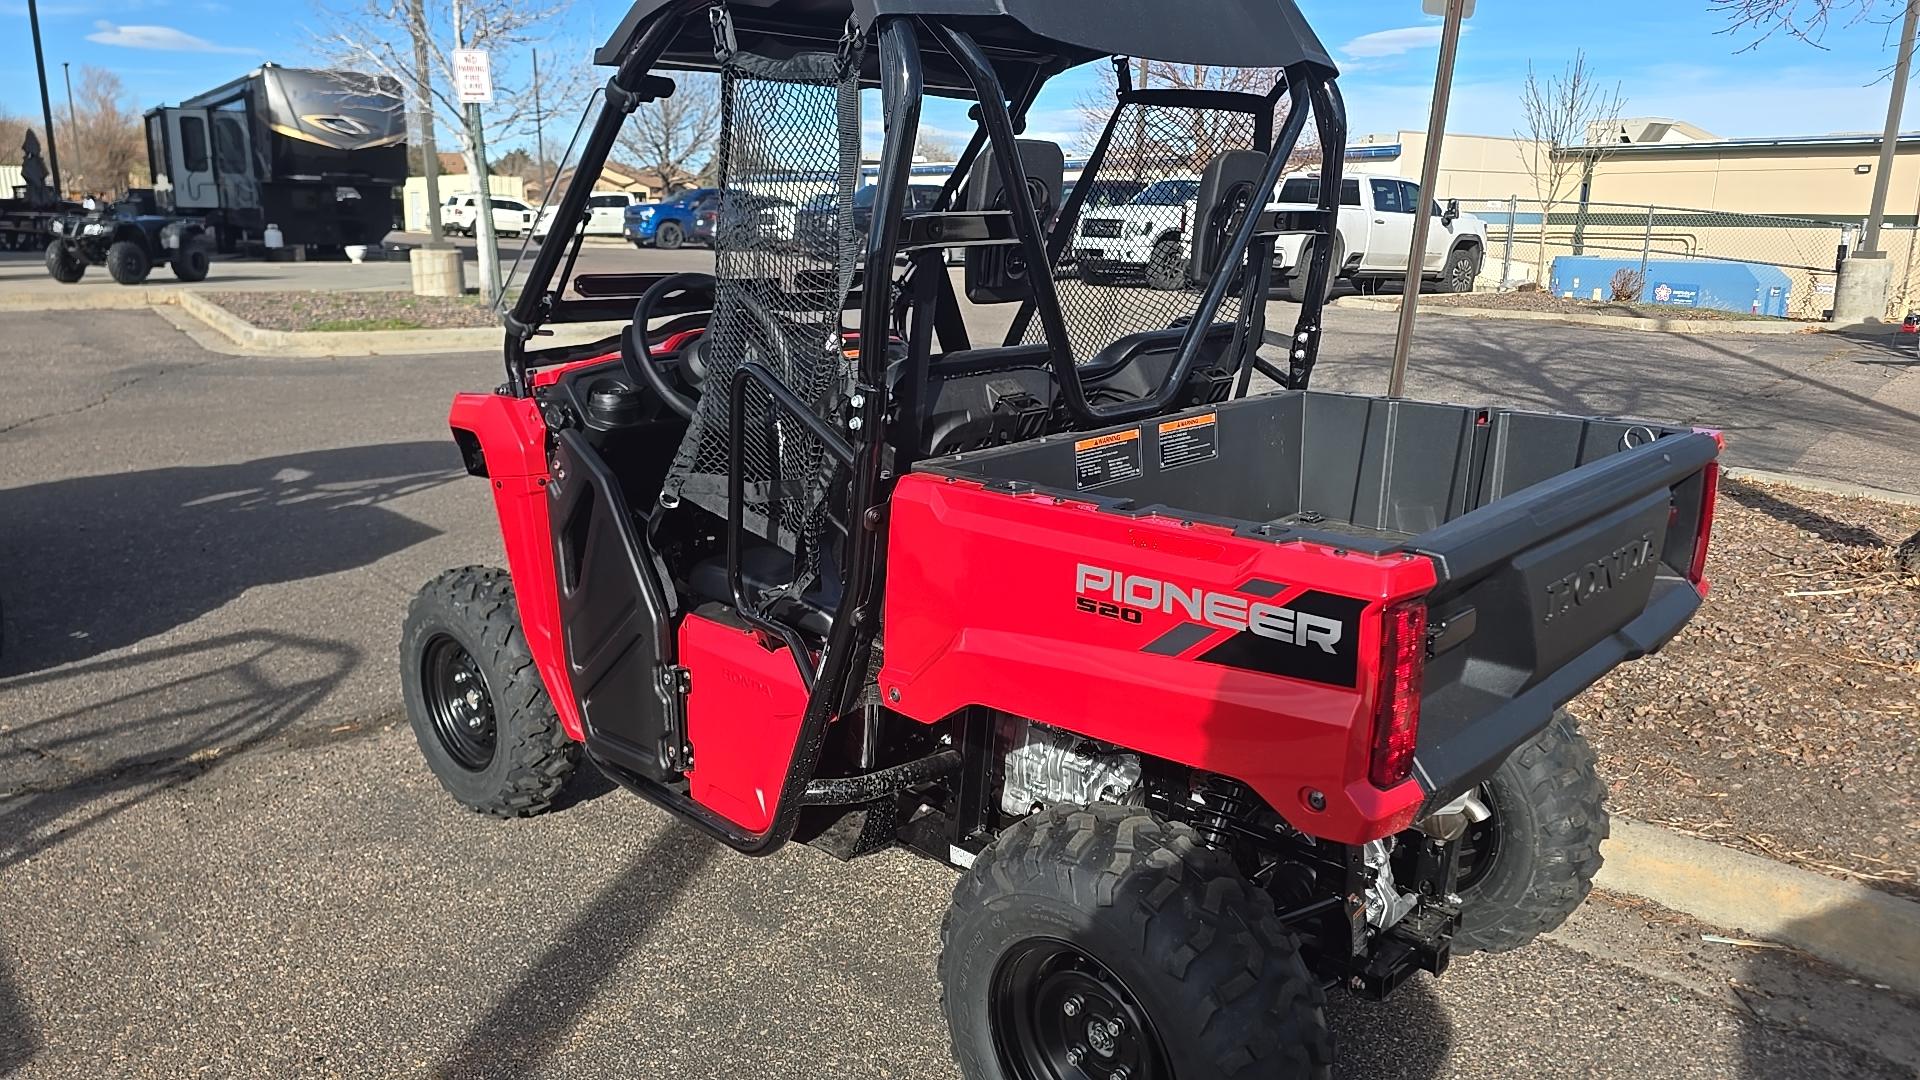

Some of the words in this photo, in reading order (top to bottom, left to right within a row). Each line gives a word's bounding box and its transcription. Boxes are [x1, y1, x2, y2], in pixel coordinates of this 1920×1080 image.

[1098, 434, 1121, 445] WARNING
[1075, 562, 1343, 655] PIONEER
[1542, 530, 1657, 626] HONDA
[1075, 596, 1143, 625] 520
